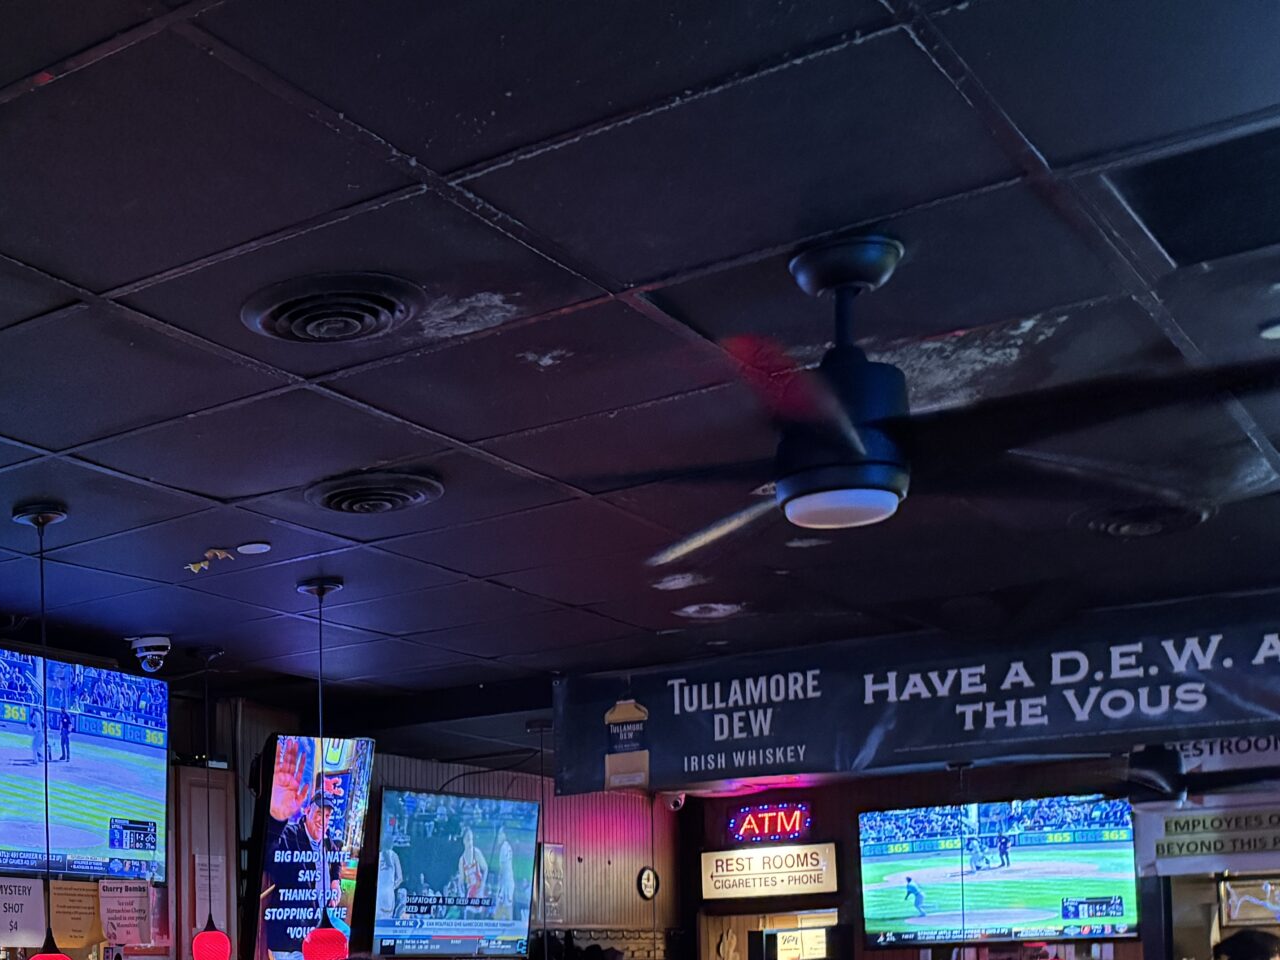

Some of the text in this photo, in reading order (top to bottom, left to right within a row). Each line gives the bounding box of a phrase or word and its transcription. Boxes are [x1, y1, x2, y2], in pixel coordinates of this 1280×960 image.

[863, 664, 987, 704] HAVE
[1000, 661, 1036, 691] A
[1051, 633, 1233, 686] D.E.W.
[667, 669, 821, 715] TULLAMORE
[956, 681, 1208, 731] THE VOUS
[1175, 735, 1280, 759] ESTROO
[684, 745, 807, 772] IRISH WHISKEY
[738, 809, 802, 836] ATM
[1164, 814, 1259, 833] EMPLOYEES
[1155, 836, 1267, 856] BEYOND THIS
[274, 850, 351, 863] BIG DADD NATE
[714, 851, 821, 874] REST ROOMS
[298, 869, 321, 882] SAYS
[713, 873, 824, 891] CIGARETTES PHONE
[278, 889, 318, 901] THANKS
[3, 902, 24, 914] SHOT
[264, 907, 347, 920] STOPPING THE
[9, 920, 19, 932] $4
